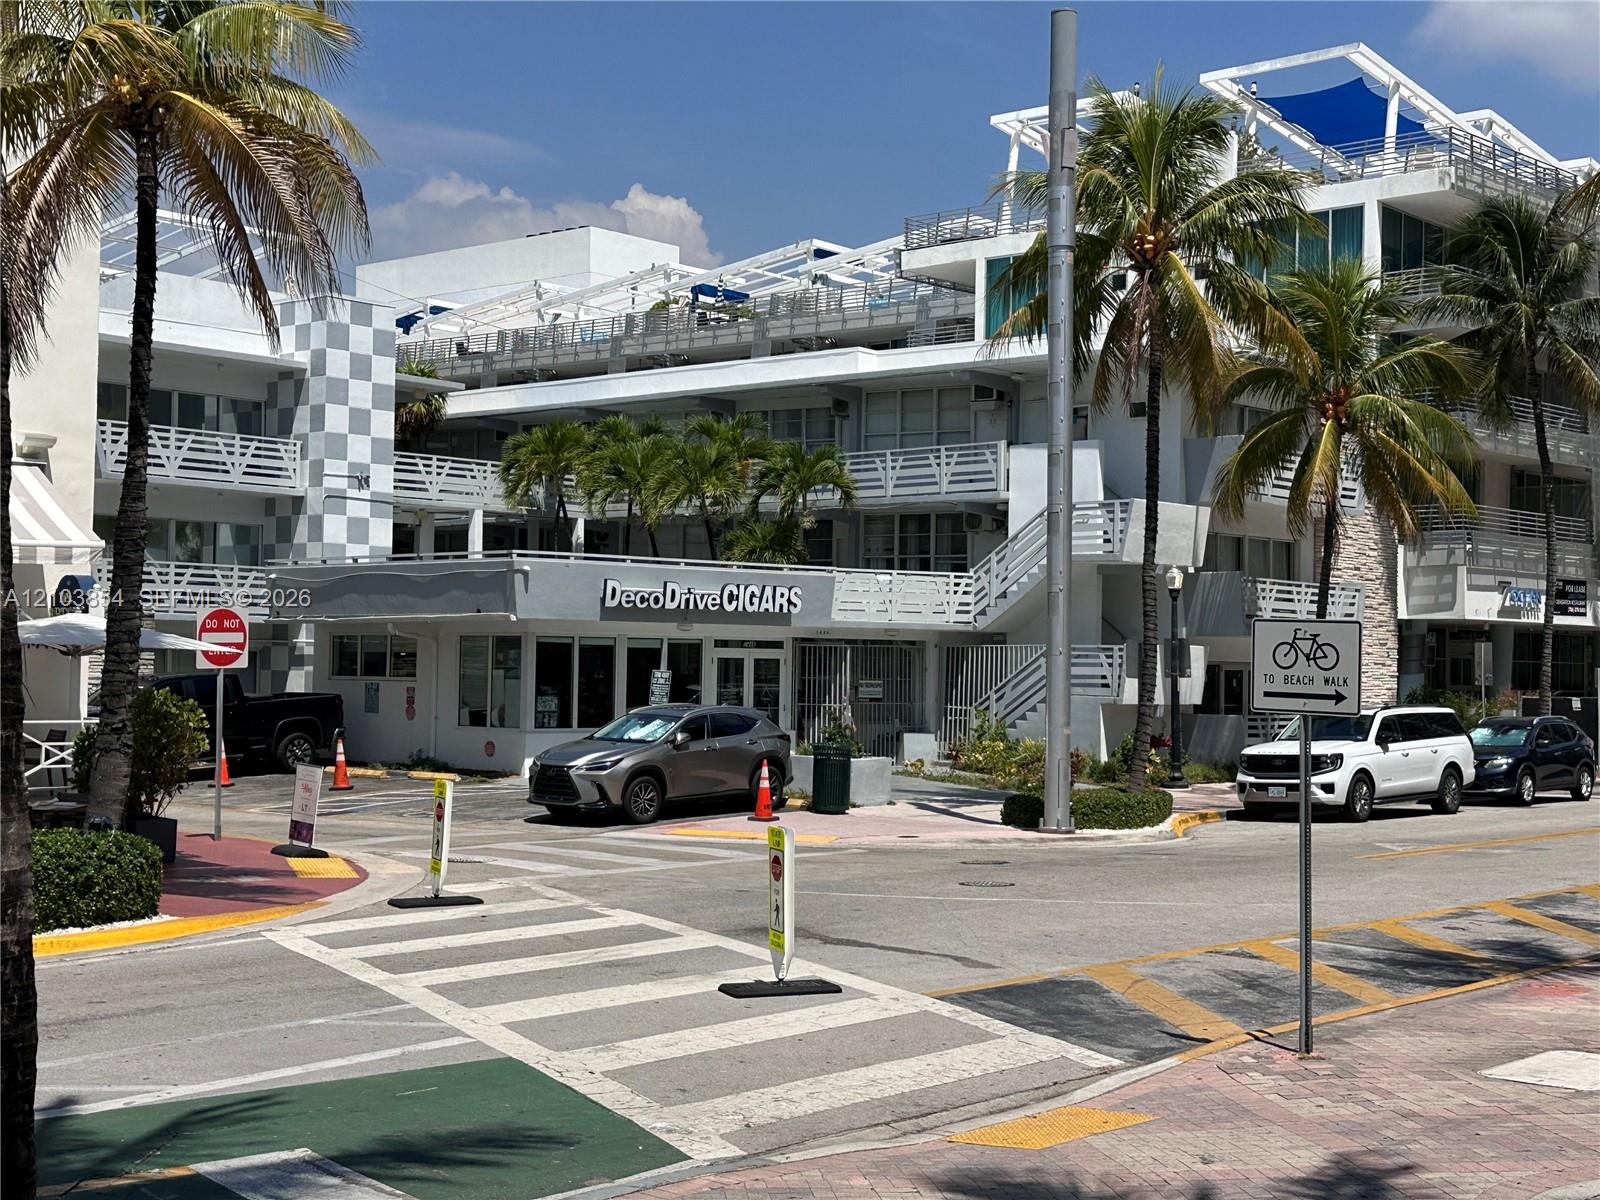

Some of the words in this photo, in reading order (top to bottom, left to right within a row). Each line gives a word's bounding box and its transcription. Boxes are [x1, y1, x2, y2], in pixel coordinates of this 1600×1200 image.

[1565, 584, 1574, 593] FOR
[1574, 585, 1586, 594] LEASE
[205, 619, 218, 629] DO
[223, 619, 240, 629] NOT
[1263, 673, 1275, 684] TO
[1283, 674, 1314, 686] BEACH
[1323, 675, 1349, 687] WALK
